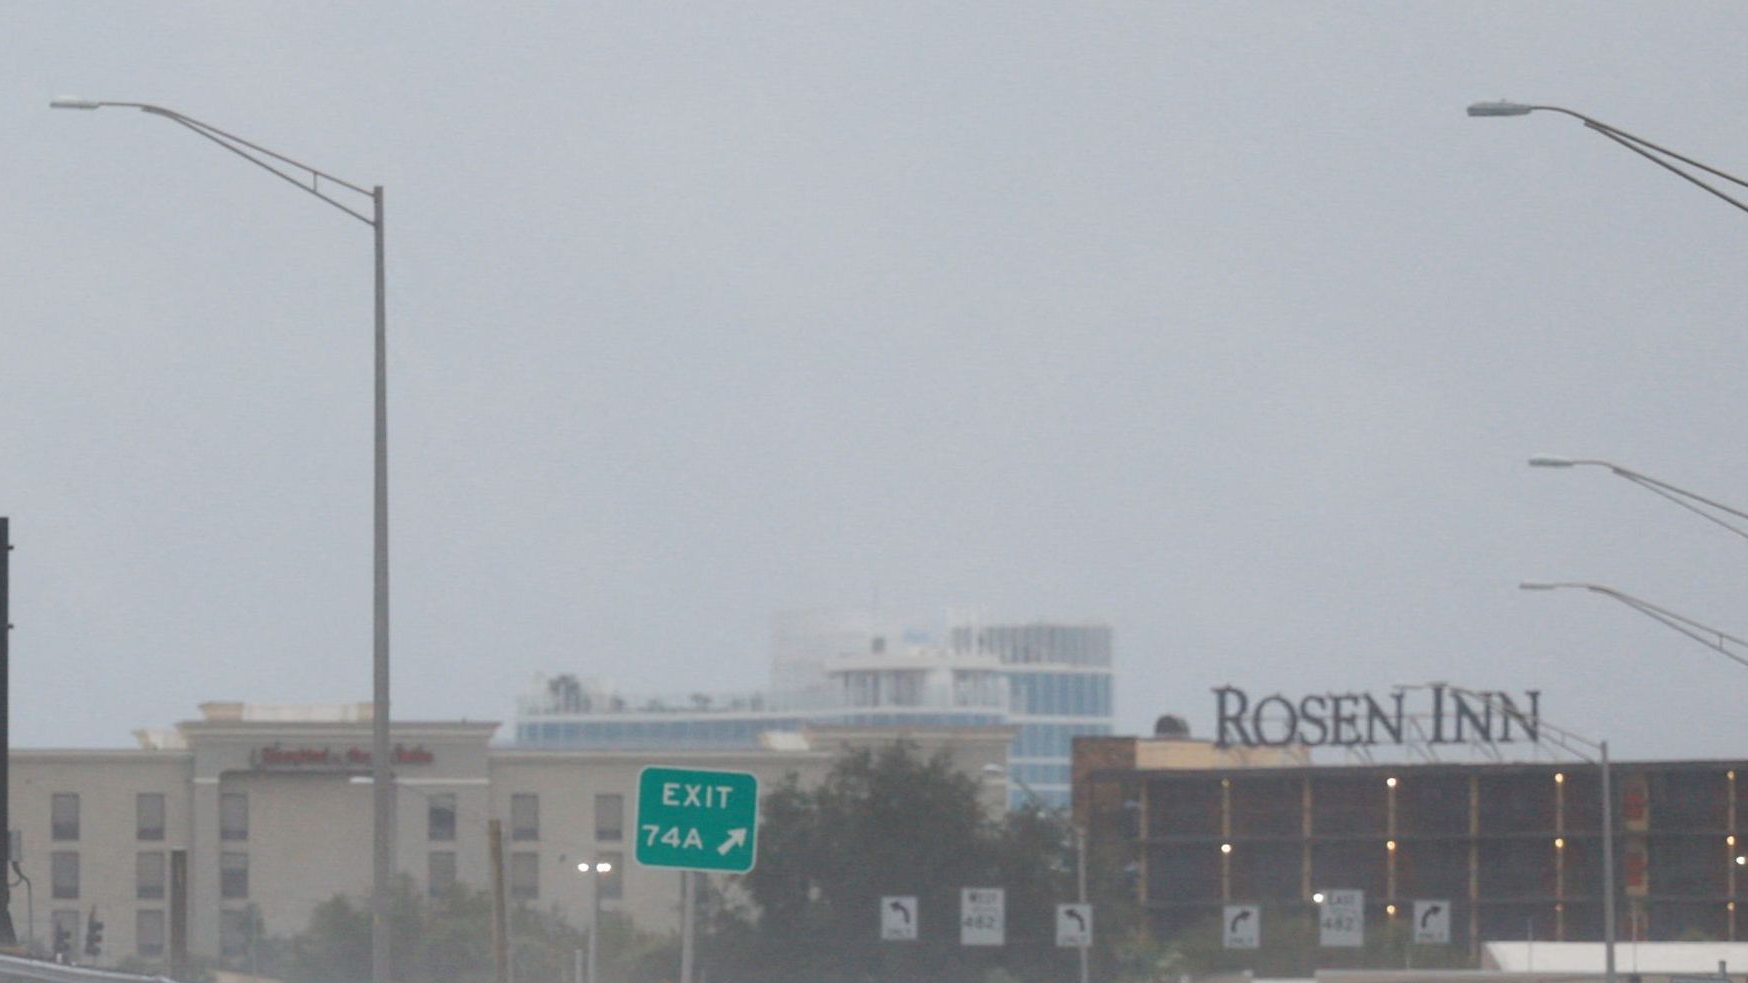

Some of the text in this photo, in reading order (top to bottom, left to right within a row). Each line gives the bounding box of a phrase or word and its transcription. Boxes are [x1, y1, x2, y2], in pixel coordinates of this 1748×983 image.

[1211, 682, 1541, 748] ROSEN INN
[662, 782, 734, 809] EXIT
[642, 824, 703, 850] 74A
